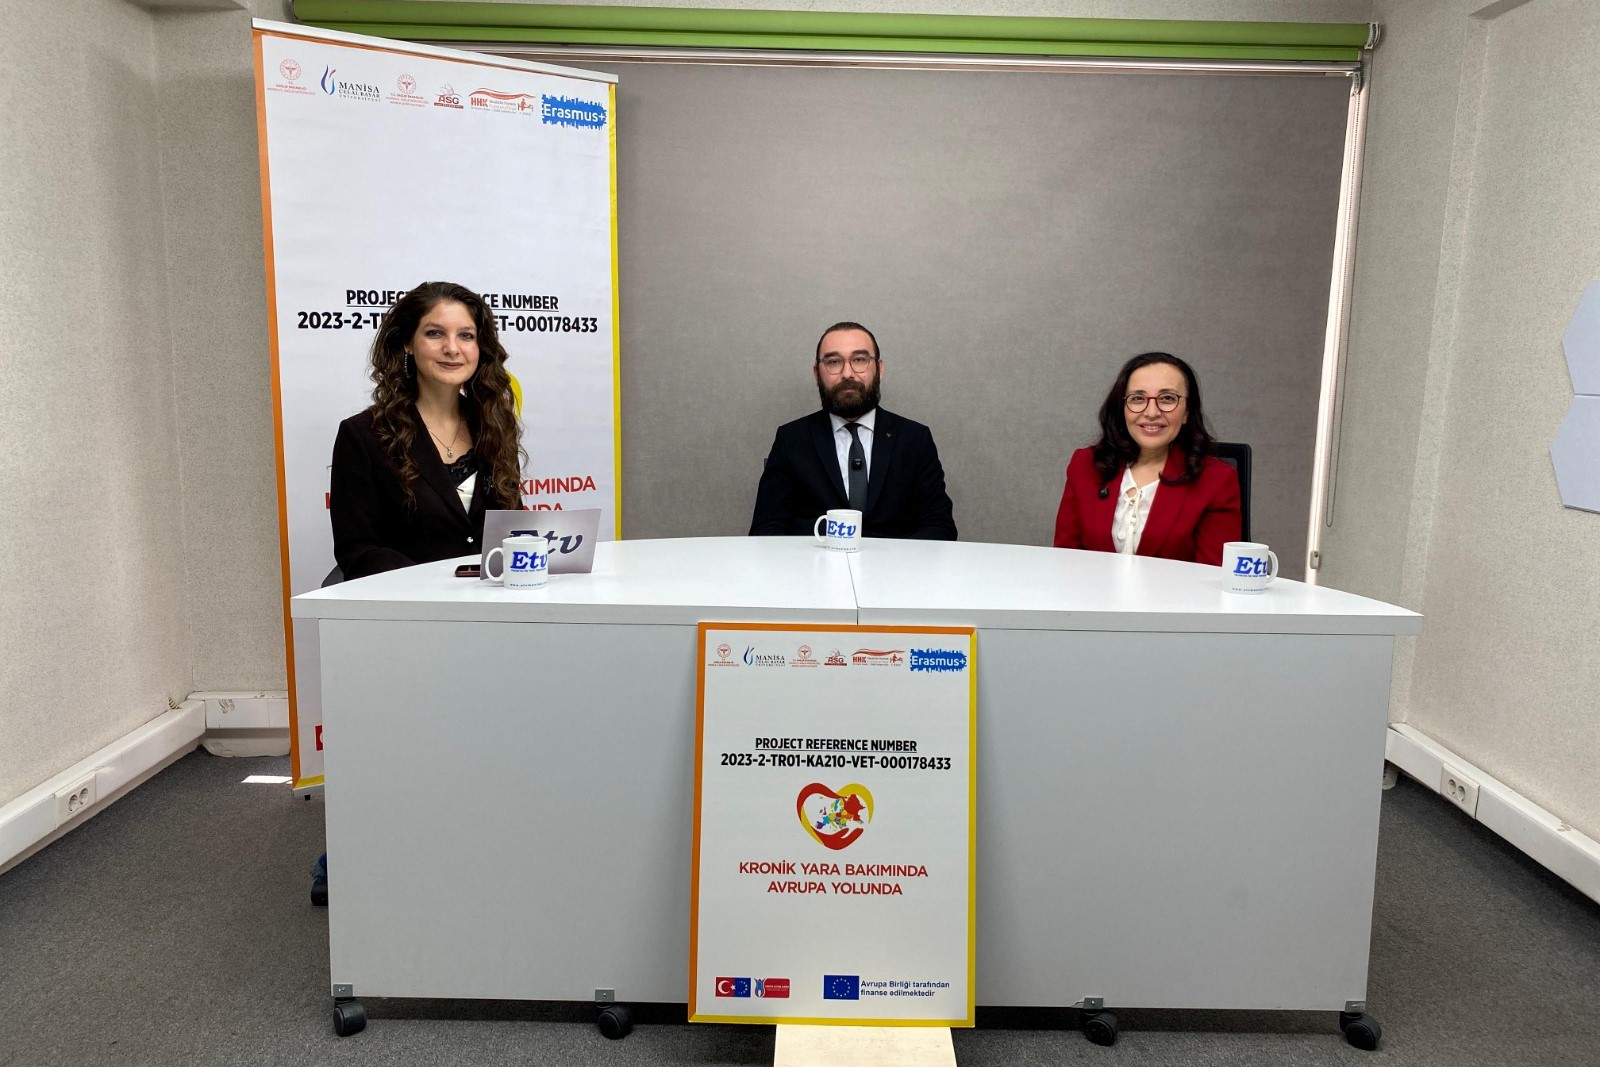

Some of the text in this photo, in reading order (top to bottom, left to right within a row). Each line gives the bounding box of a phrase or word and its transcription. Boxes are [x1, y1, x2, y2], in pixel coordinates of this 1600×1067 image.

[339, 81, 380, 93] MANİSA
[438, 95, 460, 105] ASG
[470, 97, 488, 108] HHK
[543, 103, 606, 123] Erasmus+
[346, 289, 408, 305] PROJEC
[502, 294, 559, 310] NUMBER
[519, 476, 596, 495] KIMINDA
[827, 520, 856, 536] Etv
[911, 655, 966, 667] Erasmus+
[755, 738, 917, 752] PROJECT REFERENCE NUMBER
[721, 753, 951, 770] 2023-2-TR01-KA210-VET-000178433
[739, 860, 928, 877] KRONİK YARA BAKIMINDA
[767, 881, 903, 895] AVRUPA YOLUNDA
[860, 980, 950, 989] Avrupa Birliği tarafından
[889, 989, 935, 997] edilmektedir
